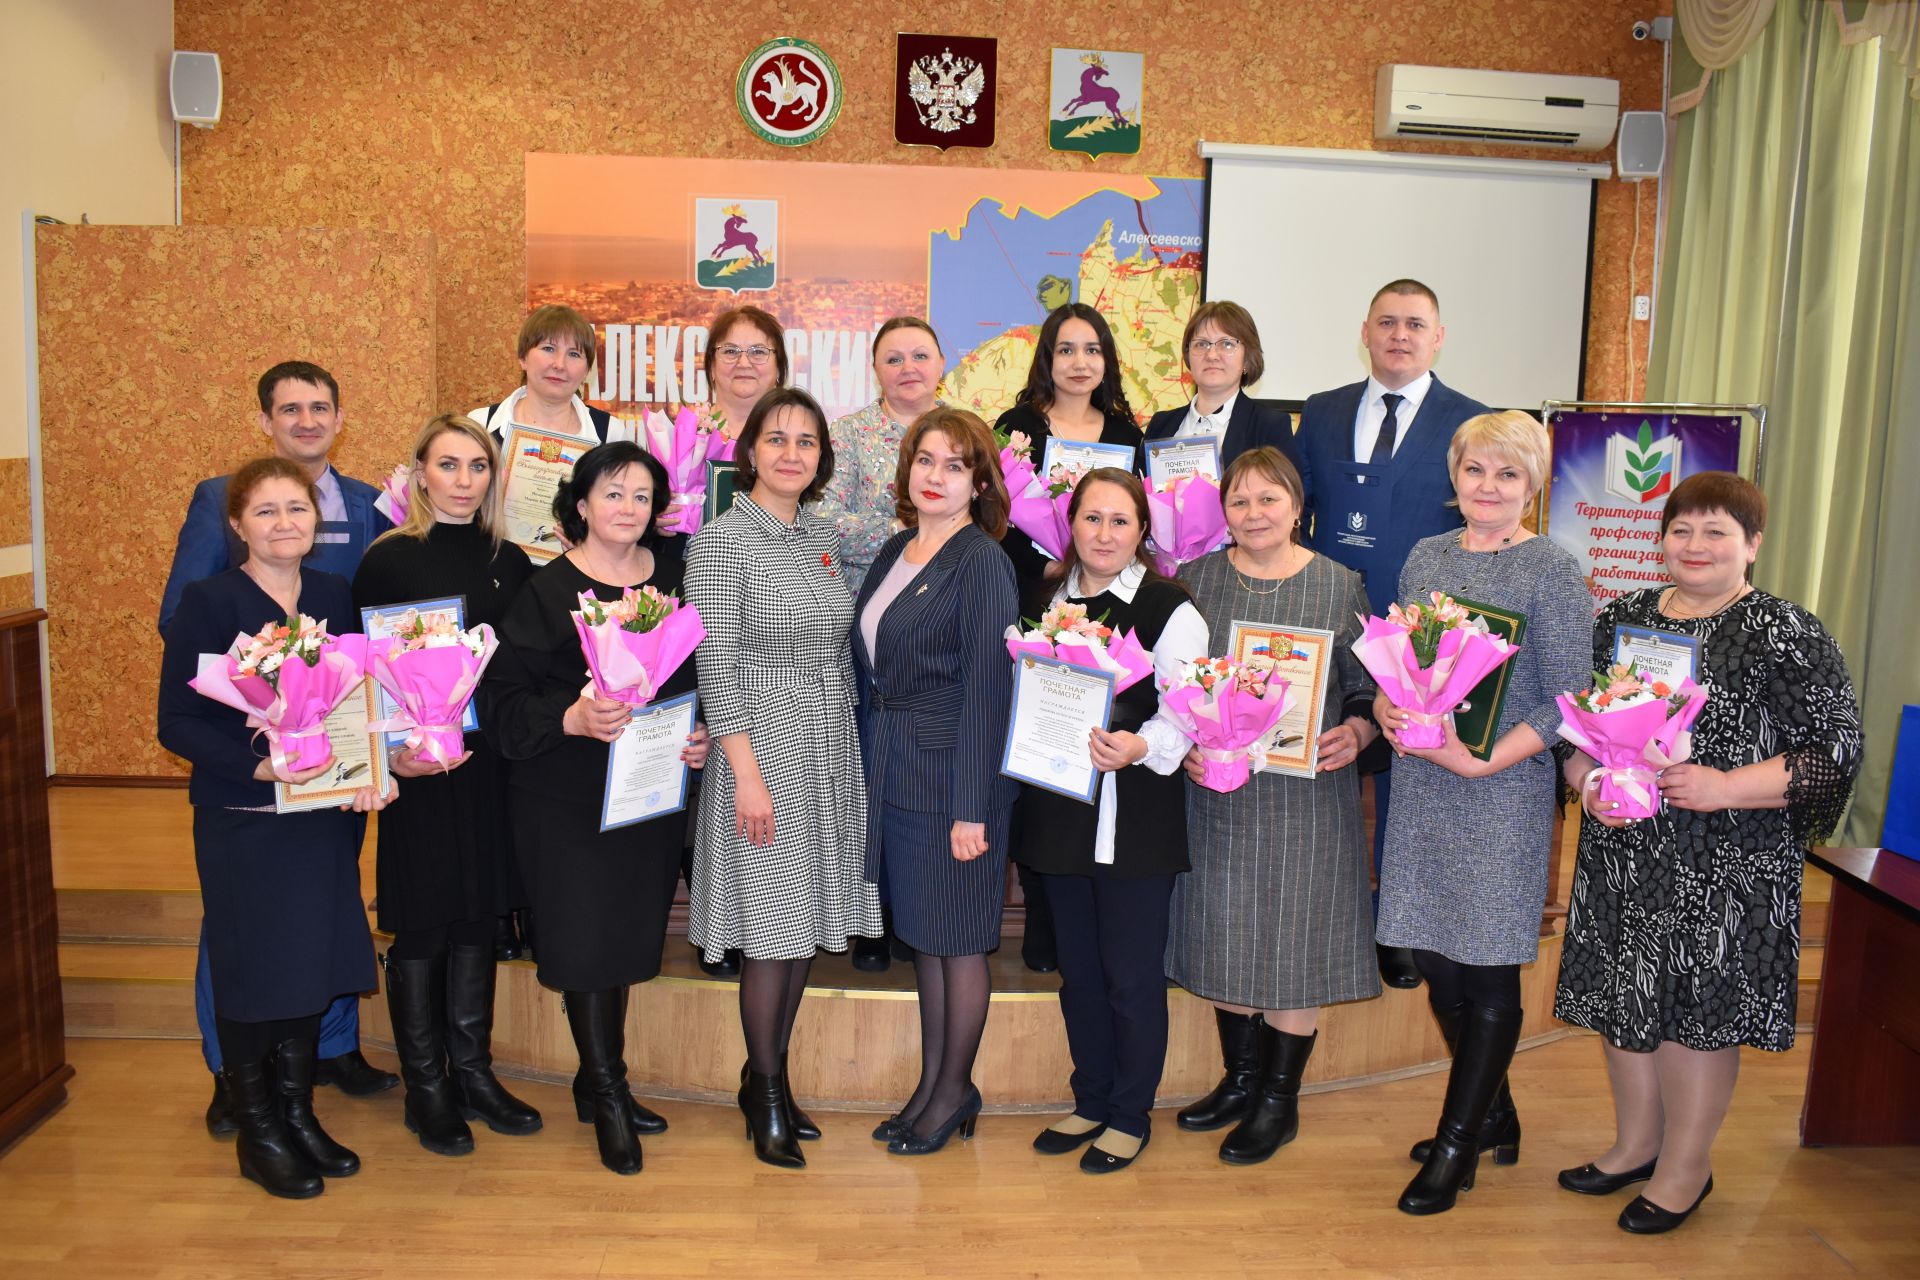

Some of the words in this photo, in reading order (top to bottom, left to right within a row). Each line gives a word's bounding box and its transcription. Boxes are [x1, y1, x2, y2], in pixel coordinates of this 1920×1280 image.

[1118, 230, 1202, 246] Алексеевско
[1165, 459, 1200, 468] ПОЧЕТНАЯ
[1575, 502, 1663, 523] Территориа
[1590, 526, 1663, 545] профсоюз
[1589, 546, 1665, 565] организац
[1592, 566, 1673, 583] работнико
[1634, 654, 1673, 668] ПОЧЕТНАЯ
[1040, 678, 1086, 695] ПОЧЕТНАЯ
[1043, 685, 1082, 701] ГРАМОТА
[636, 722, 676, 736] ПОЧЕТНАЯ
[639, 730, 672, 742] ГРАМОТА
